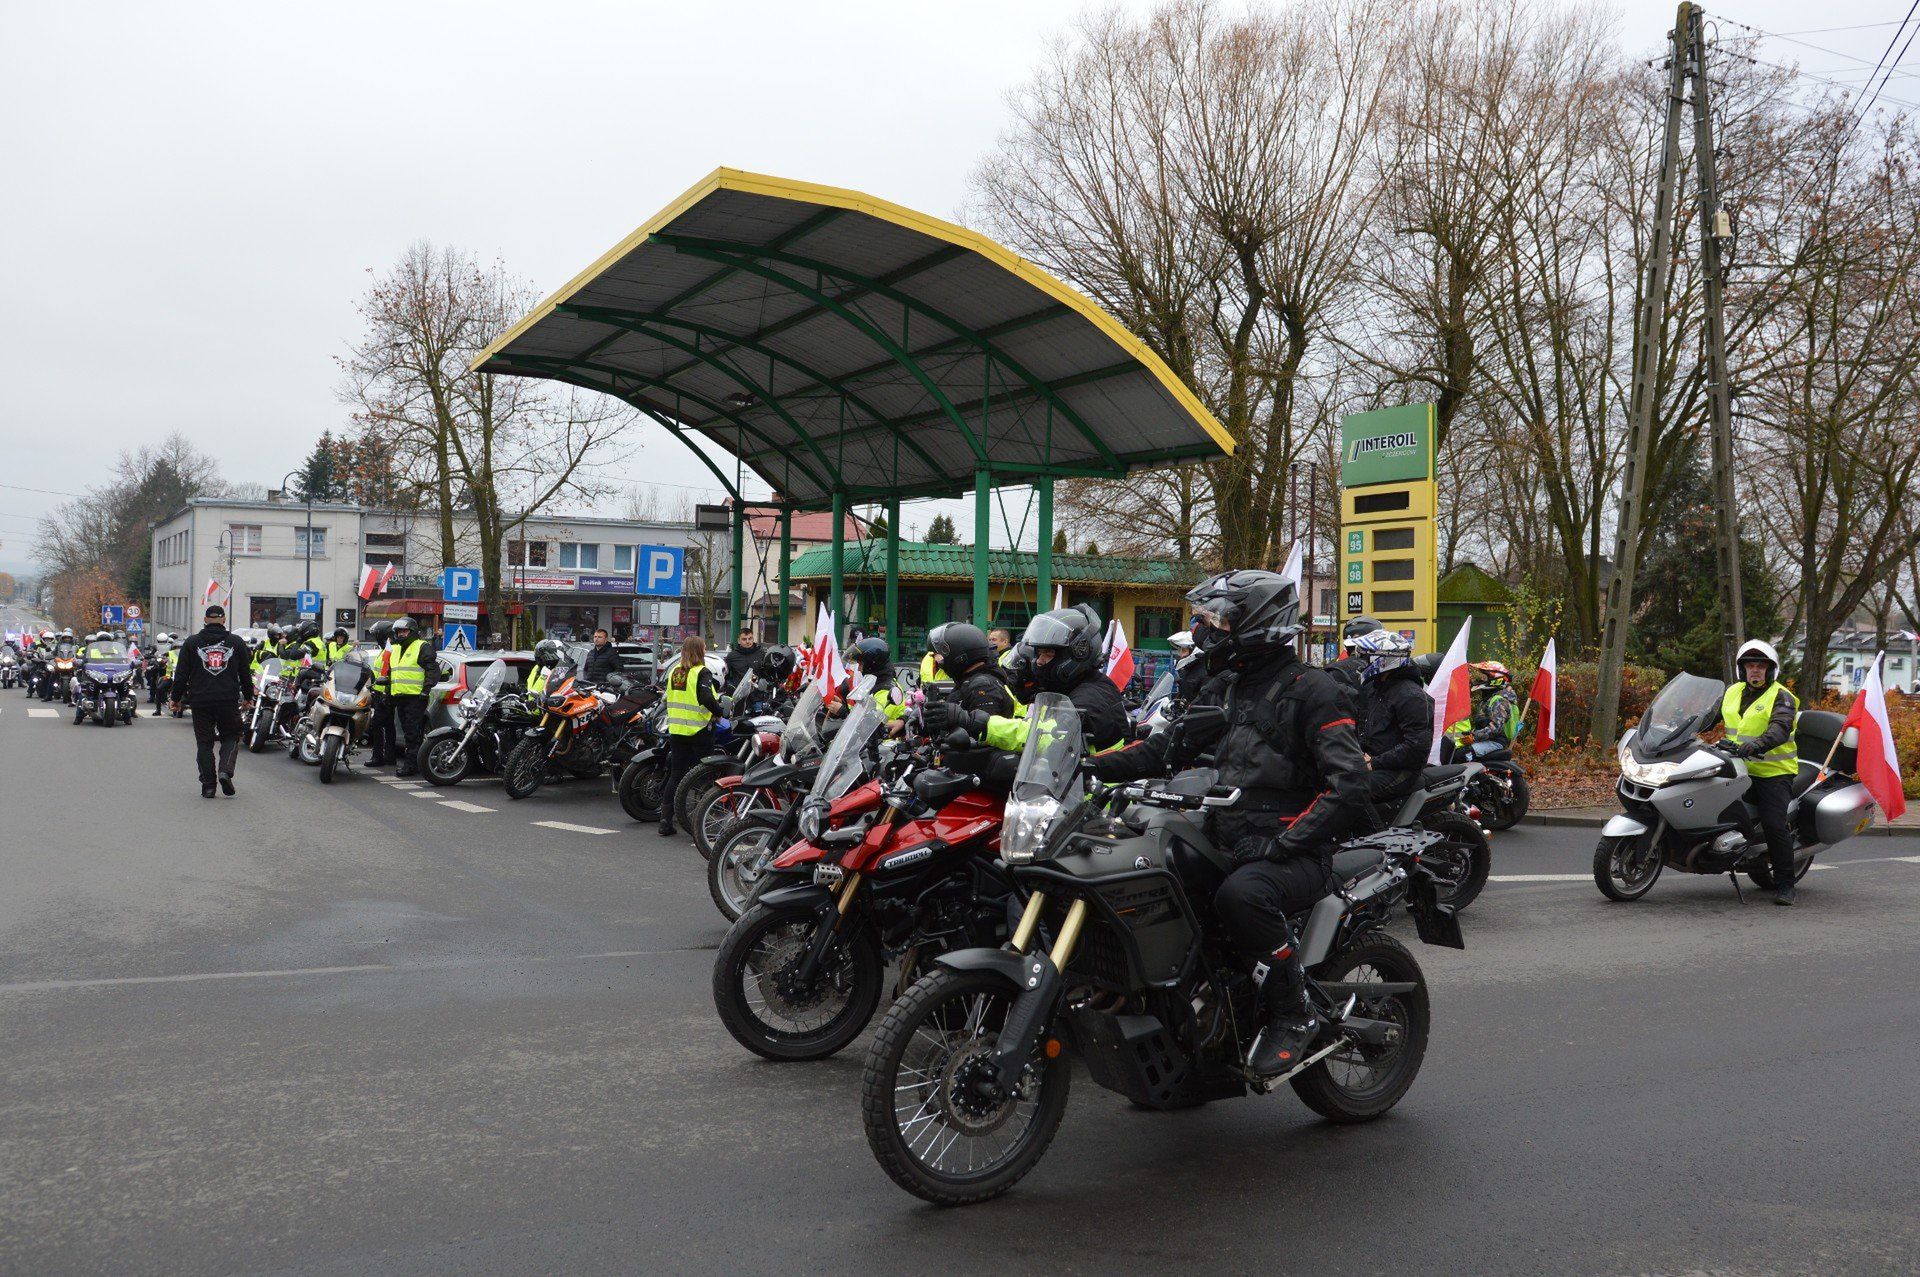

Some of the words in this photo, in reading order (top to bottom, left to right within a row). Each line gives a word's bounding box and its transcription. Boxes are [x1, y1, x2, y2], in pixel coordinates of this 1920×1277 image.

[1362, 432, 1416, 452] INTEROIL
[1350, 540, 1362, 551] 95
[648, 551, 675, 589] P
[1349, 571, 1361, 581] 98
[452, 571, 472, 598] P
[302, 593, 316, 610] P
[1349, 594, 1362, 606] ON
[128, 607, 140, 615] 30
[1150, 790, 1184, 801] Barkbusters
[888, 850, 929, 867] TRIUMPH
